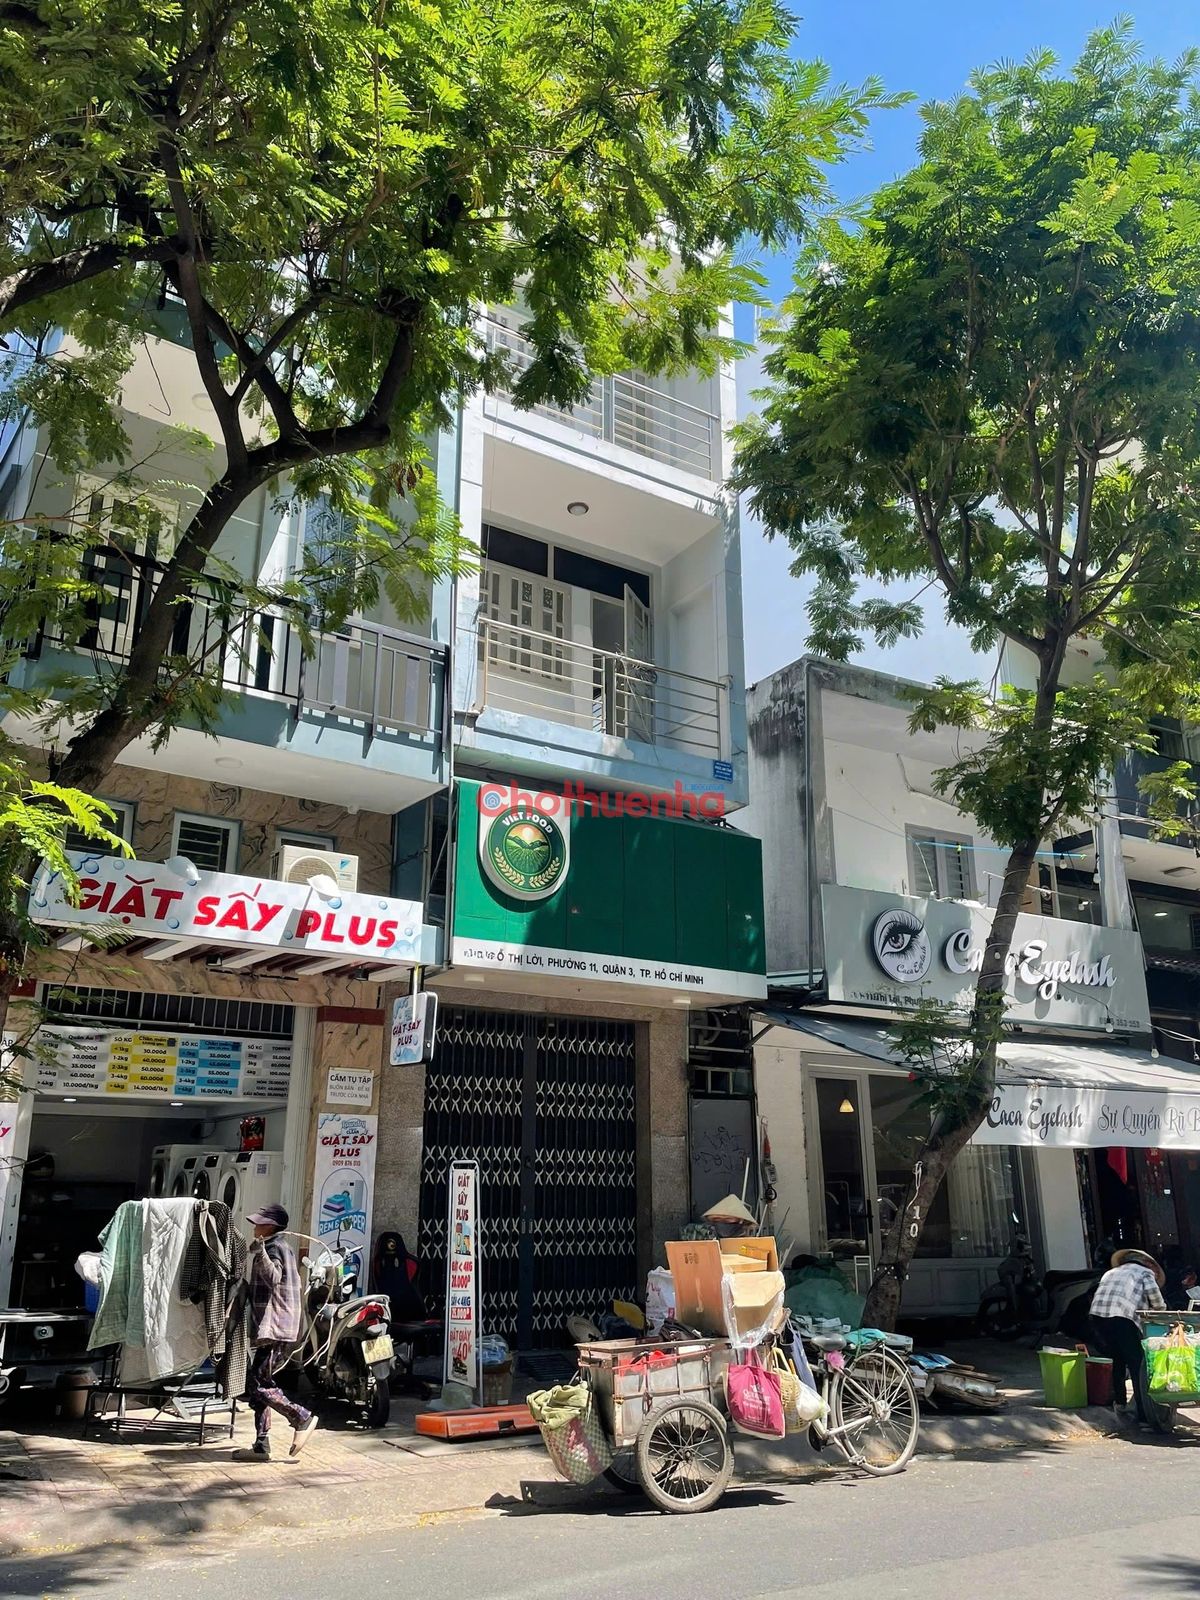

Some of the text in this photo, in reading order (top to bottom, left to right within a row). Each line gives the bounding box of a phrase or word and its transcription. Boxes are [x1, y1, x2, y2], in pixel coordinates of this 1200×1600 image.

[526, 812, 553, 834] FOOD
[70, 874, 398, 949] GIẶT SẤY PLUS
[508, 953, 523, 965] THỊ
[526, 953, 544, 967] LỜI,
[547, 957, 586, 971] PHƯỜNG
[602, 963, 627, 977] QUẬN
[639, 968, 651, 978] TP.
[669, 971, 682, 982] CHÍ
[684, 975, 704, 985] MINH
[945, 927, 1118, 1000] Caa Eyelash
[330, 1073, 372, 1085] CẤM TỤ TẬP
[986, 1096, 1024, 1129] Caca
[1028, 1097, 1084, 1140] Eyelash
[1097, 1104, 1118, 1134] Sự
[321, 1133, 350, 1148] GIẶT
[333, 1148, 361, 1158] PLUS
